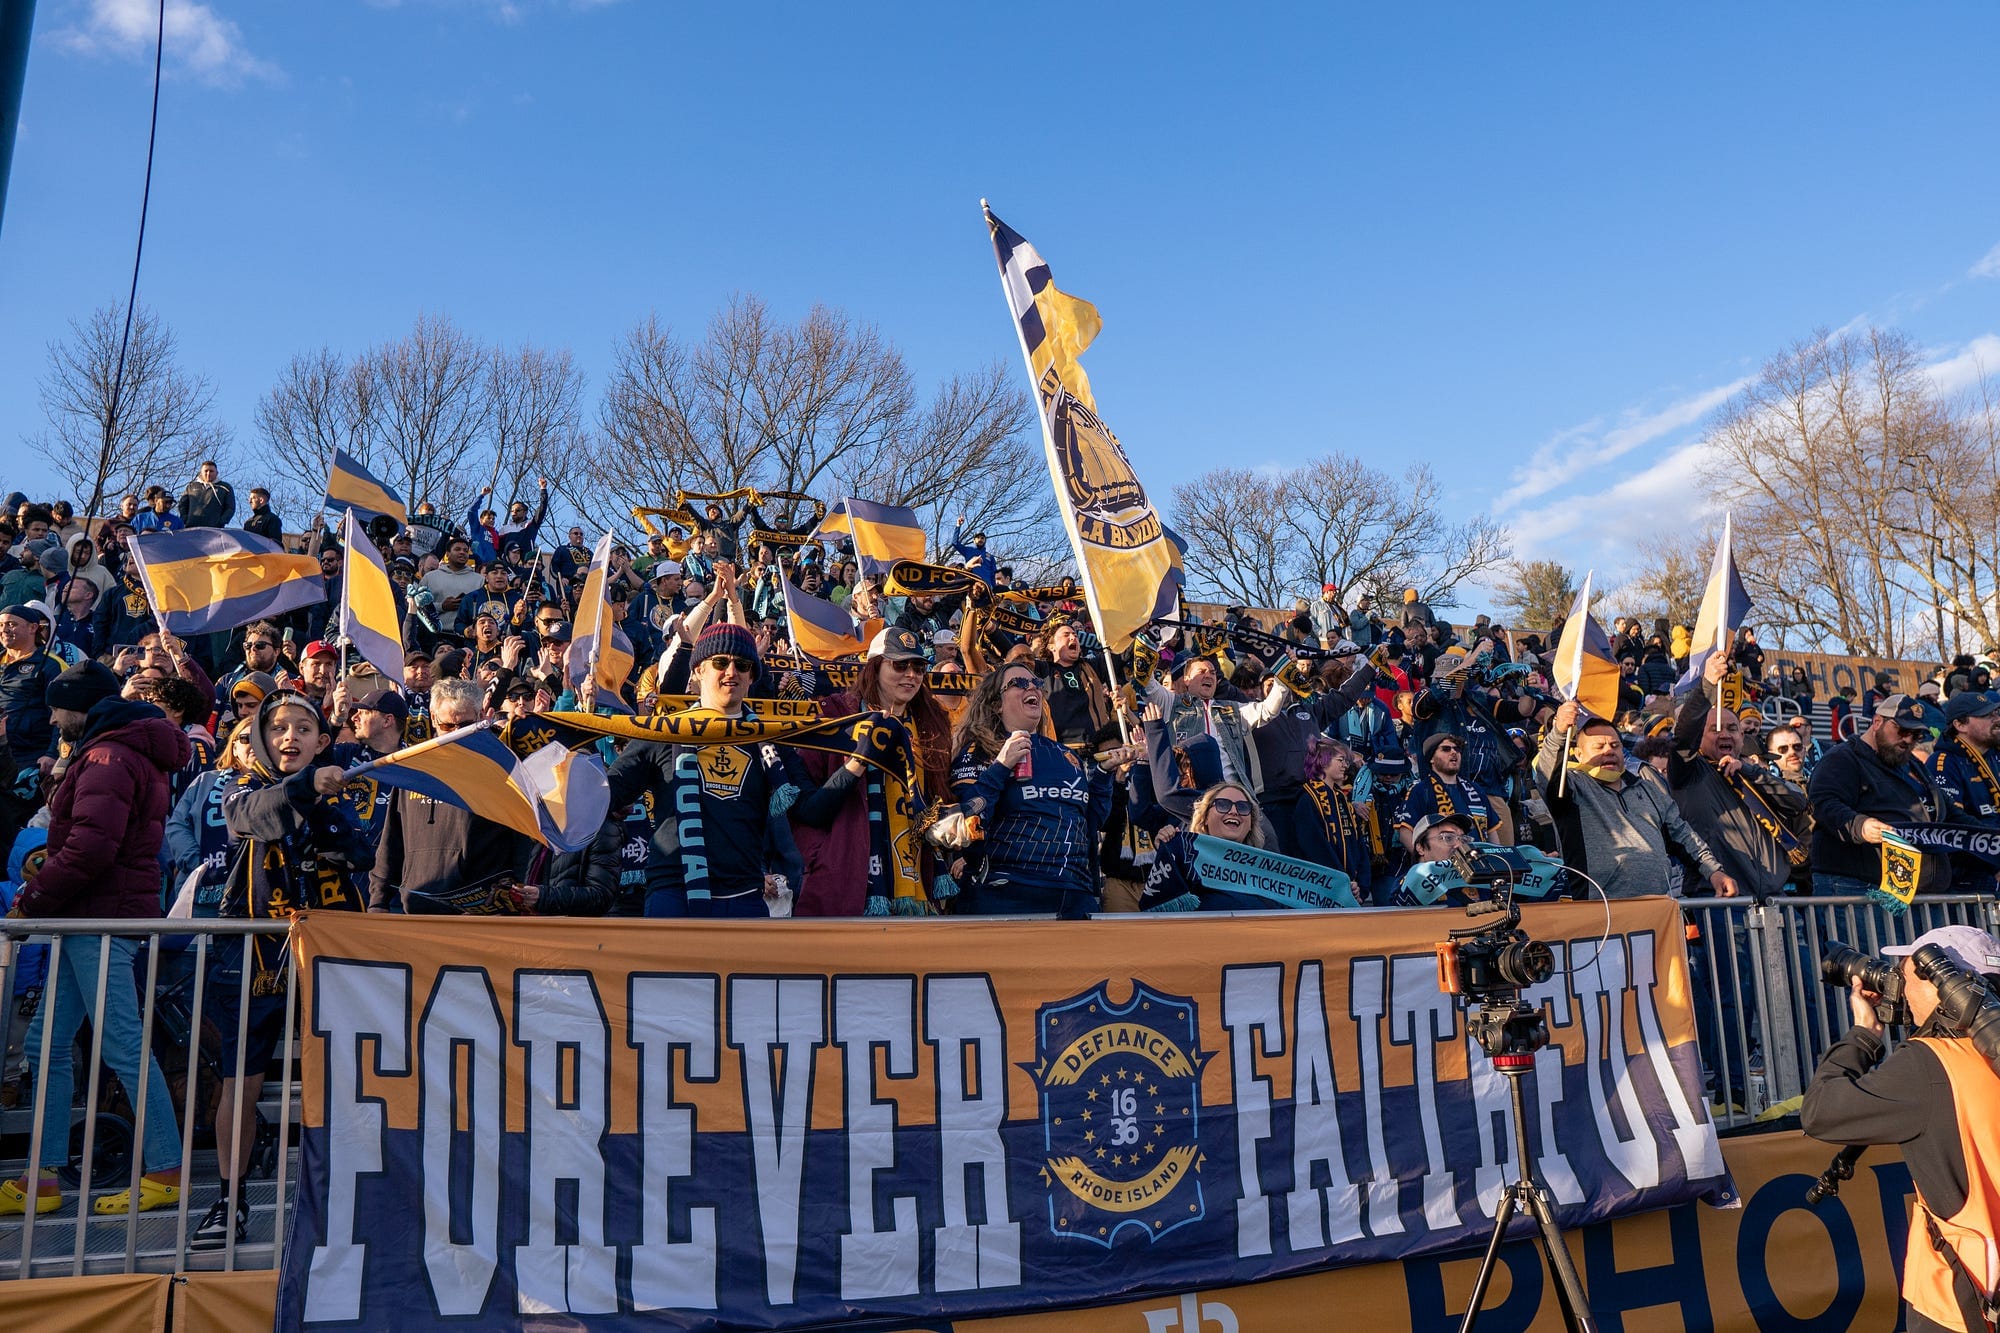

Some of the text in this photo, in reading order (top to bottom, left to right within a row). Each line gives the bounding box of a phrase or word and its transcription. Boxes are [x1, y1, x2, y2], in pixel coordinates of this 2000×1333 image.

[1077, 516, 1161, 547] LA BANDA
[895, 567, 956, 583] ND FC
[764, 656, 814, 672] HODE
[928, 673, 984, 690] LAND
[772, 701, 820, 717] ISLA
[851, 719, 893, 752] FC
[1021, 784, 1089, 804] Breeze
[1968, 832, 2000, 856] 163
[1200, 862, 1248, 886] SEASON
[1250, 873, 1295, 898] TICKET
[1223, 848, 1334, 890] 2024 INAUGURAL
[1062, 1026, 1178, 1074] DEFIANCE
[1111, 1087, 1137, 1117] 16
[301, 955, 1026, 1324] FOREVER
[1110, 1116, 1140, 1146] 36
[1070, 1160, 1179, 1204] RHODE ISLAND
